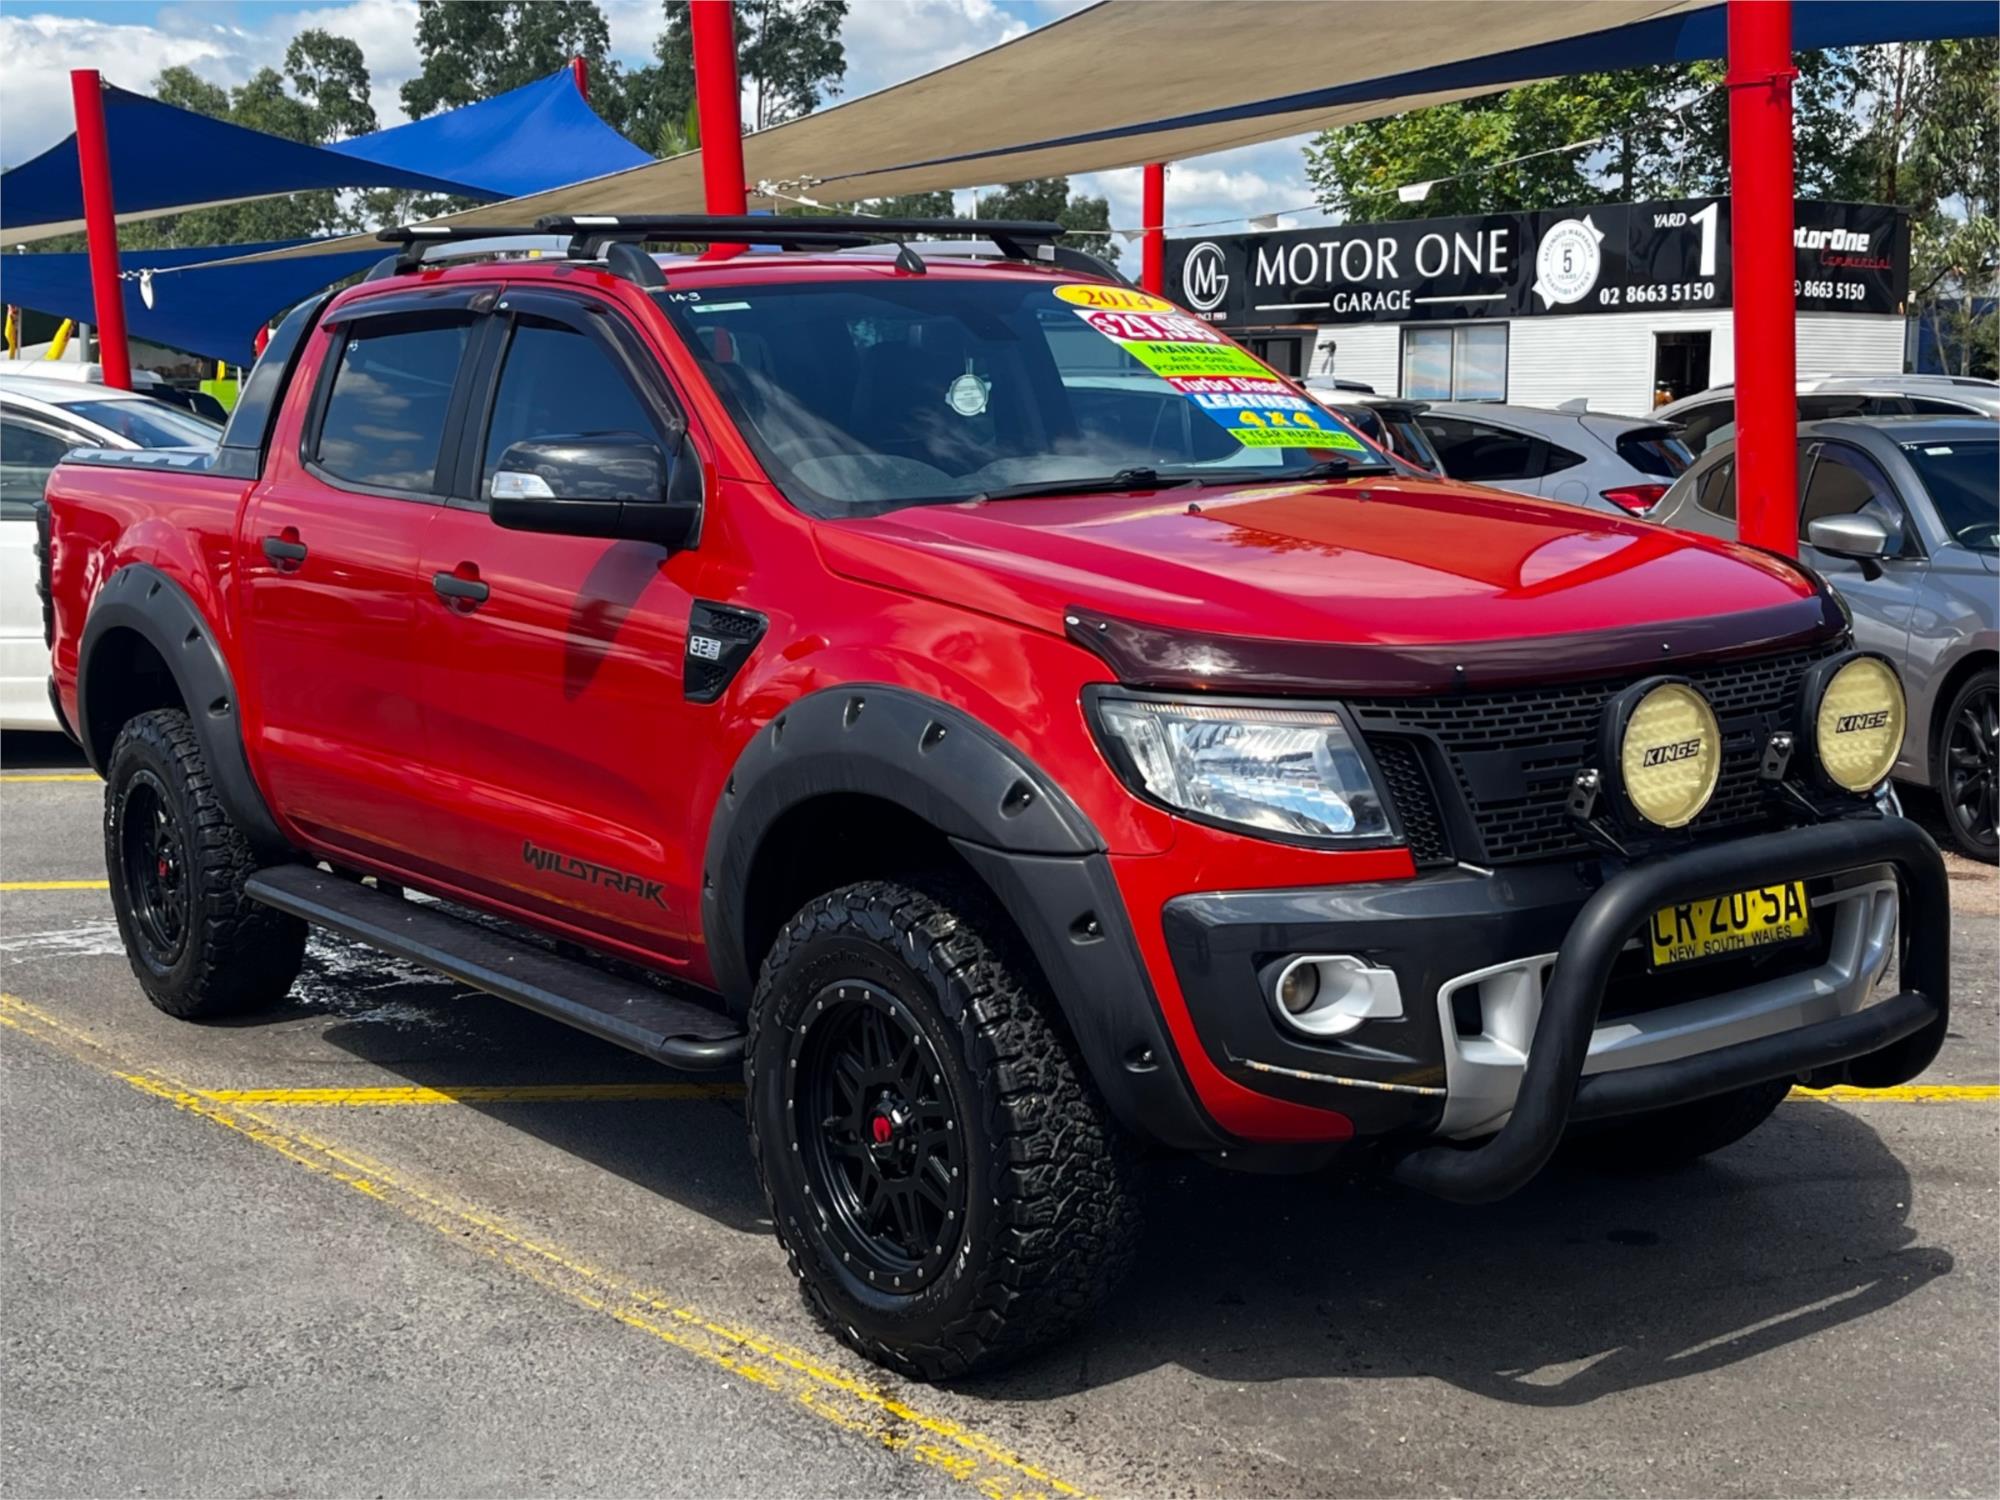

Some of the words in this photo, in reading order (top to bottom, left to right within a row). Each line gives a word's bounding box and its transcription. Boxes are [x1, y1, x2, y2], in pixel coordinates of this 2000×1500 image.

[1653, 212, 1686, 228] YARD
[1690, 202, 1718, 276] 1
[1255, 237, 1399, 287] MOTOR
[1415, 229, 1508, 278] ONE
[1563, 249, 1572, 273] 5
[1078, 290, 1153, 308] 2014
[1600, 286, 1619, 304] 02
[1627, 284, 1667, 302] 8663
[1672, 282, 1714, 301] 5150
[1804, 280, 1833, 298] 8663
[1836, 283, 1865, 300] 5150
[1333, 290, 1411, 313] GARAGE
[1148, 344, 1230, 356] MANUAL
[1171, 378, 1233, 392] Turbo
[1230, 378, 1294, 394] Diesel
[1194, 394, 1313, 412] LEATHER
[1836, 711, 1888, 733] KINGS
[1644, 739, 1701, 767] KINGS
[523, 840, 670, 911] WILDTRAK
[1669, 946, 1696, 961] NEW
[1704, 937, 1745, 955] SOUTH
[1752, 924, 1792, 944] WALES
